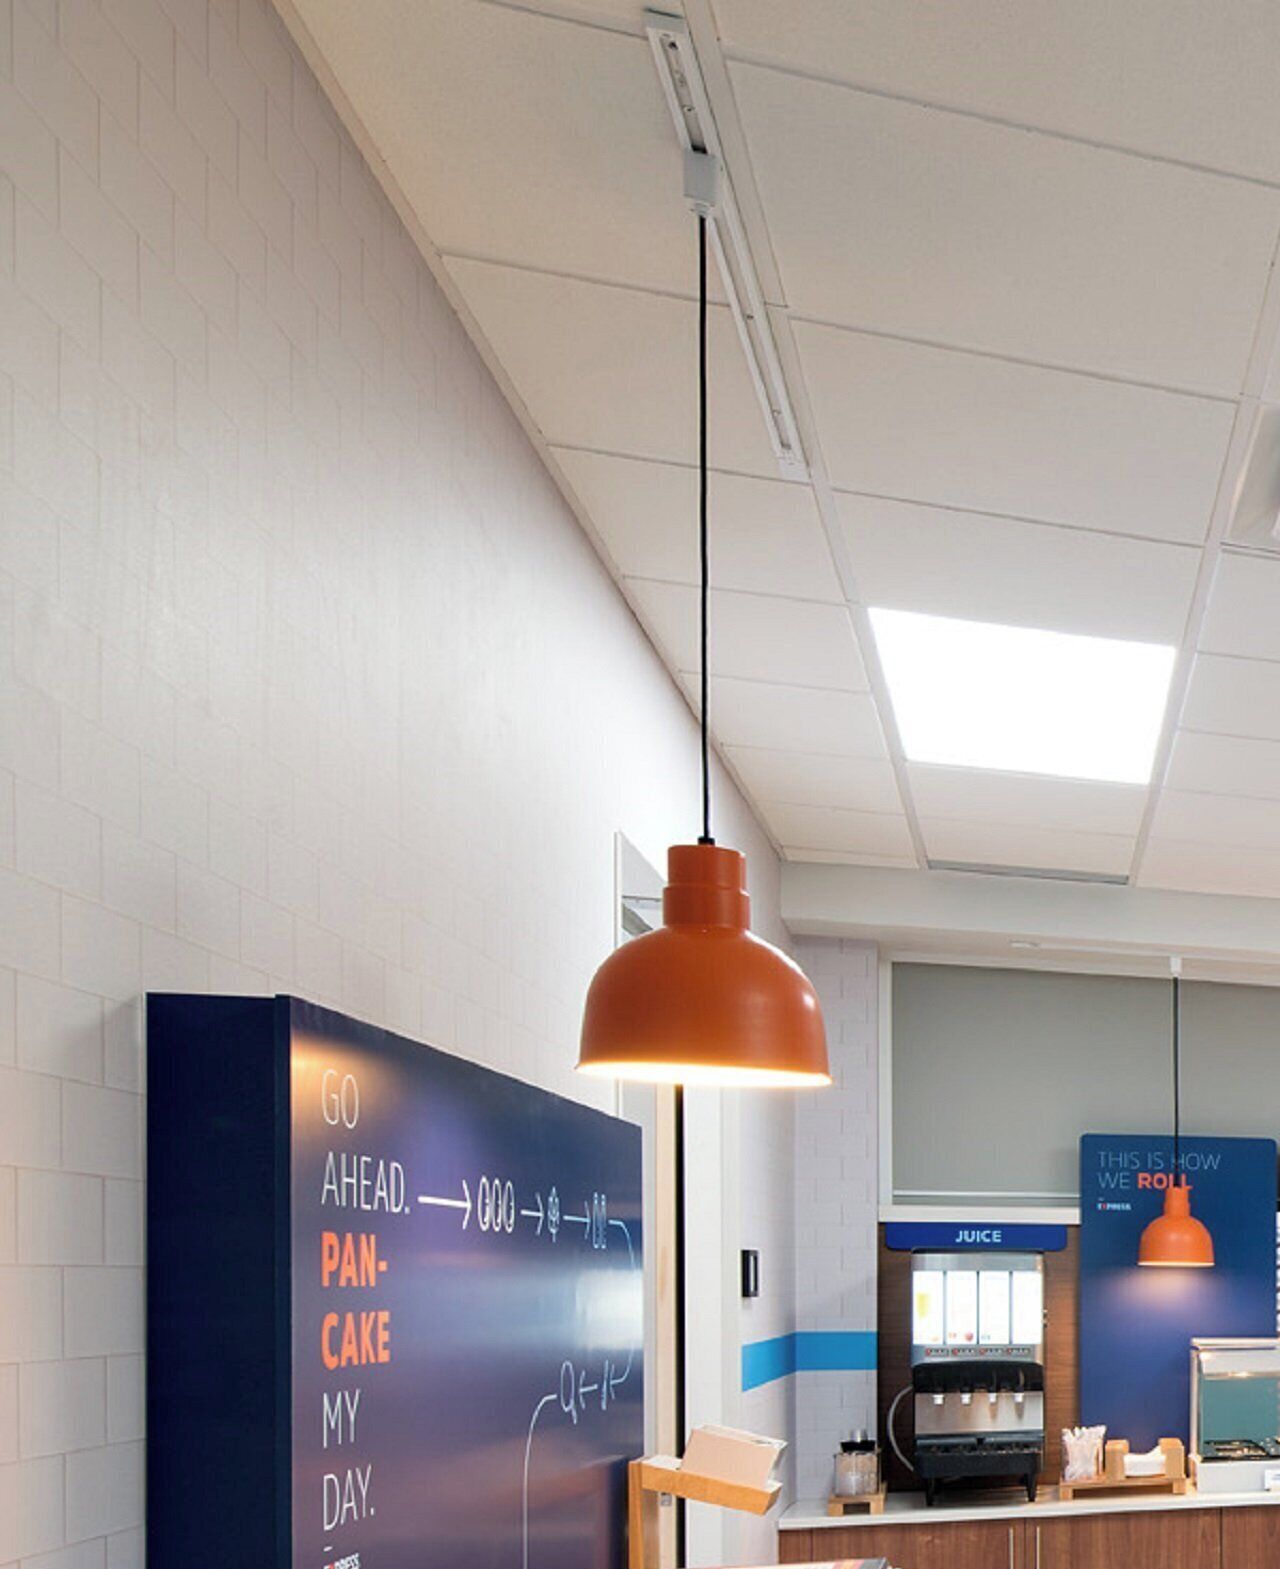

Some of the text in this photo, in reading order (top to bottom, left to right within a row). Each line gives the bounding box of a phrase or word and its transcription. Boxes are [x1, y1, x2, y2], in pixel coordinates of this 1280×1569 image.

[321, 1068, 360, 1130] GO
[321, 1150, 411, 1215] AHEAD.
[1098, 1151, 1221, 1171] THIS IS HOW
[1099, 1171, 1131, 1189] WE
[321, 1230, 388, 1288] PAN-
[954, 1229, 1003, 1244] JUICE
[321, 1311, 391, 1371] CAKE
[322, 1388, 360, 1449] MY
[322, 1463, 375, 1532] DAY.
